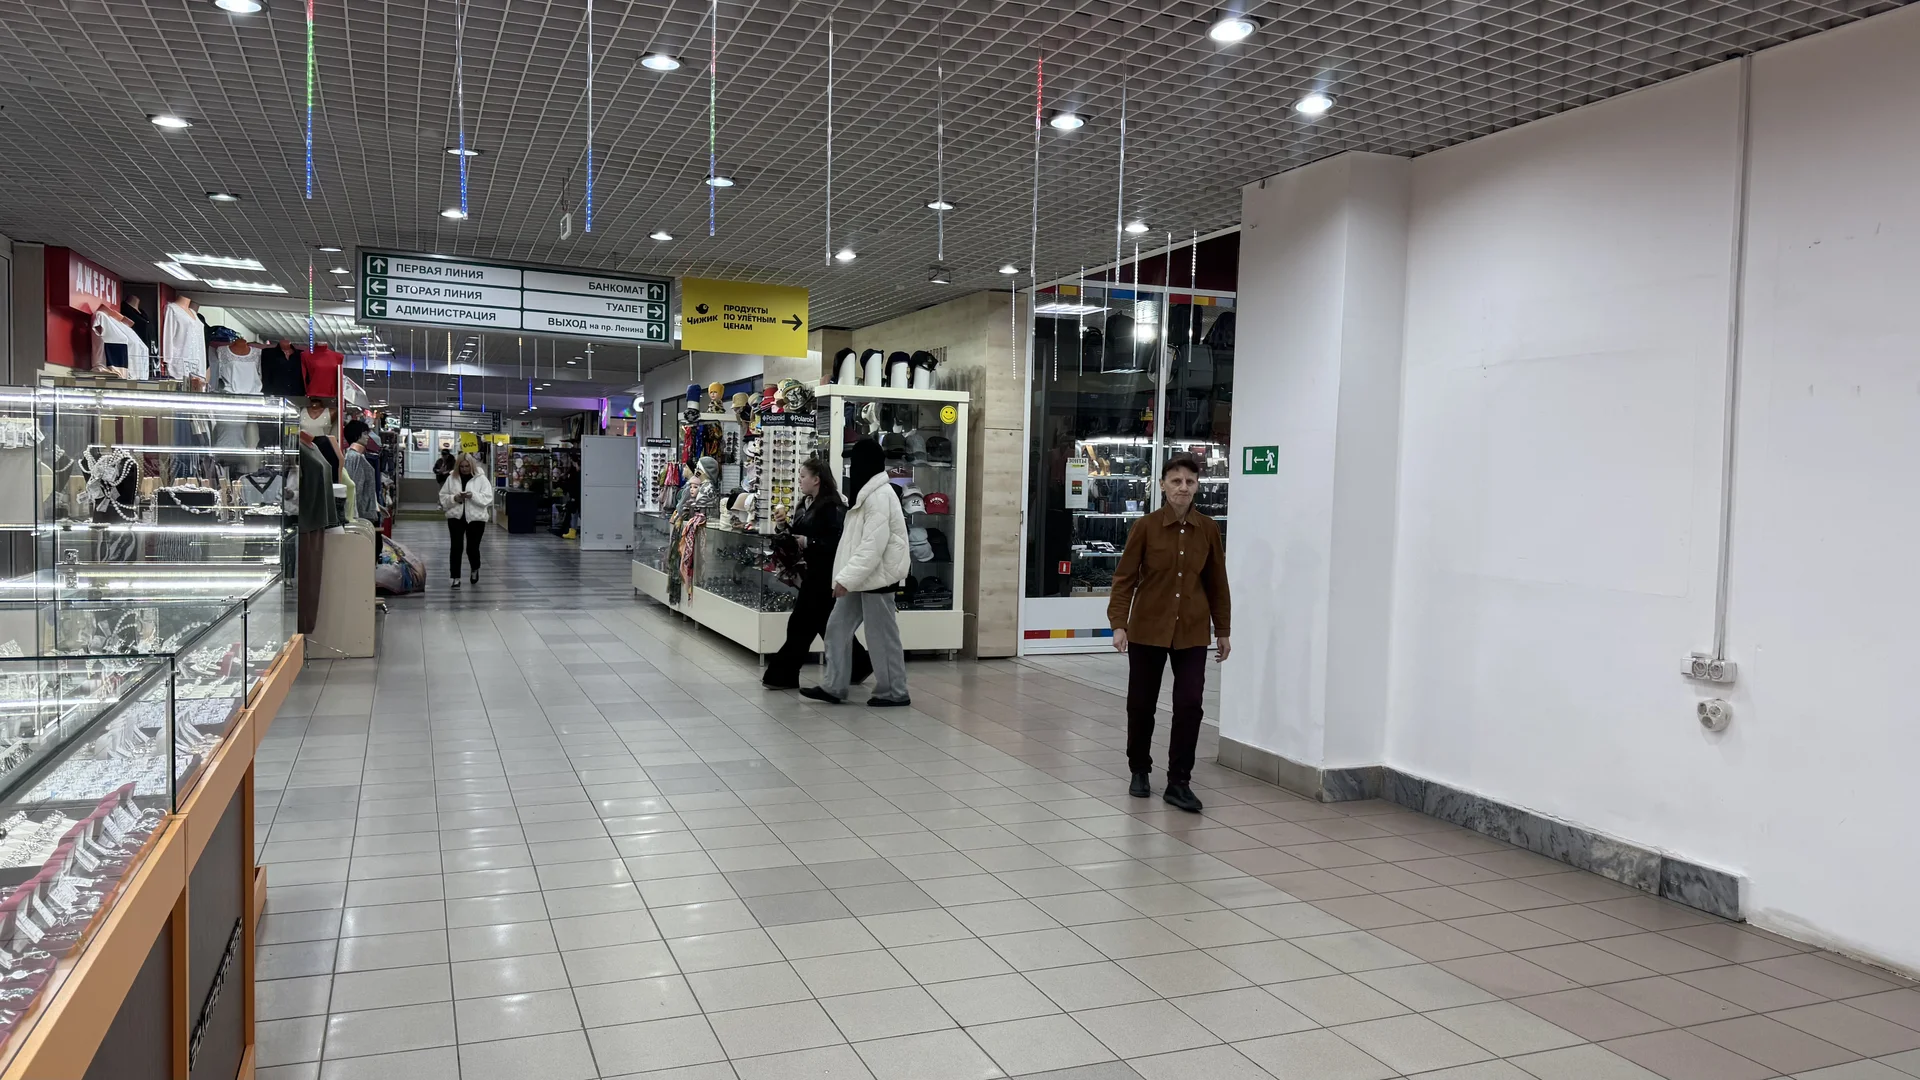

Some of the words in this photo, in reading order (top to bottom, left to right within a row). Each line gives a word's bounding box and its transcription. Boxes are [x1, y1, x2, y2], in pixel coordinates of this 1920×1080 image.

[396, 263, 442, 276] ПЕРВАЯ
[445, 268, 484, 280] ЛИНИЯ
[76, 262, 117, 306] ДЖЕРСИ
[588, 281, 645, 295] БАНКОМАТ
[396, 284, 441, 297] ВТОРАЯ
[444, 288, 482, 300] ЛИНИЯ
[395, 304, 496, 322] АДМИНИСТРАЦИЯ
[606, 302, 645, 314] ТУАЛЕТ
[723, 304, 769, 315] ПРОДУКТЫ
[548, 317, 587, 330] ВЫХОД
[615, 324, 644, 334] Ленина
[723, 313, 736, 321] ПО
[738, 313, 777, 324] УЛЁТНЫМ
[723, 322, 753, 331] ЦЕНАМ
[794, 415, 815, 423] Polaroid
